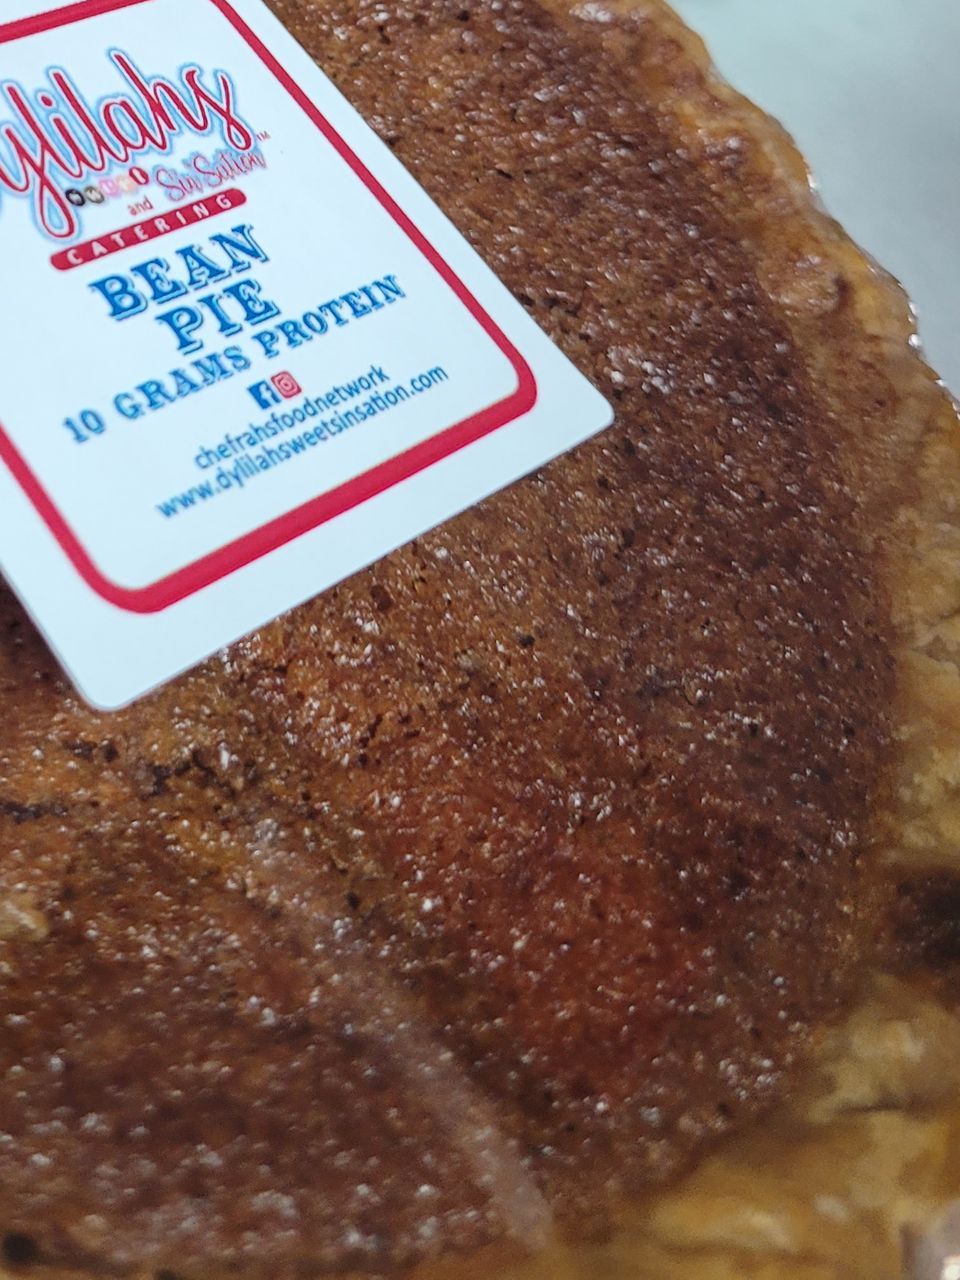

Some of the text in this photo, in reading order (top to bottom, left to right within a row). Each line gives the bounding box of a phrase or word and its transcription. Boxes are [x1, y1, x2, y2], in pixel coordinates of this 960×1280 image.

[66, 193, 233, 266] CATERING
[127, 195, 154, 216] and
[88, 223, 270, 321] BEAN
[155, 278, 281, 355] PIE
[63, 274, 408, 445] 10 GRAMS PROTEIN
[155, 365, 450, 519] www.dylilahsweetsinsation.com
[194, 365, 391, 470] chefrahsfoodnetwork
